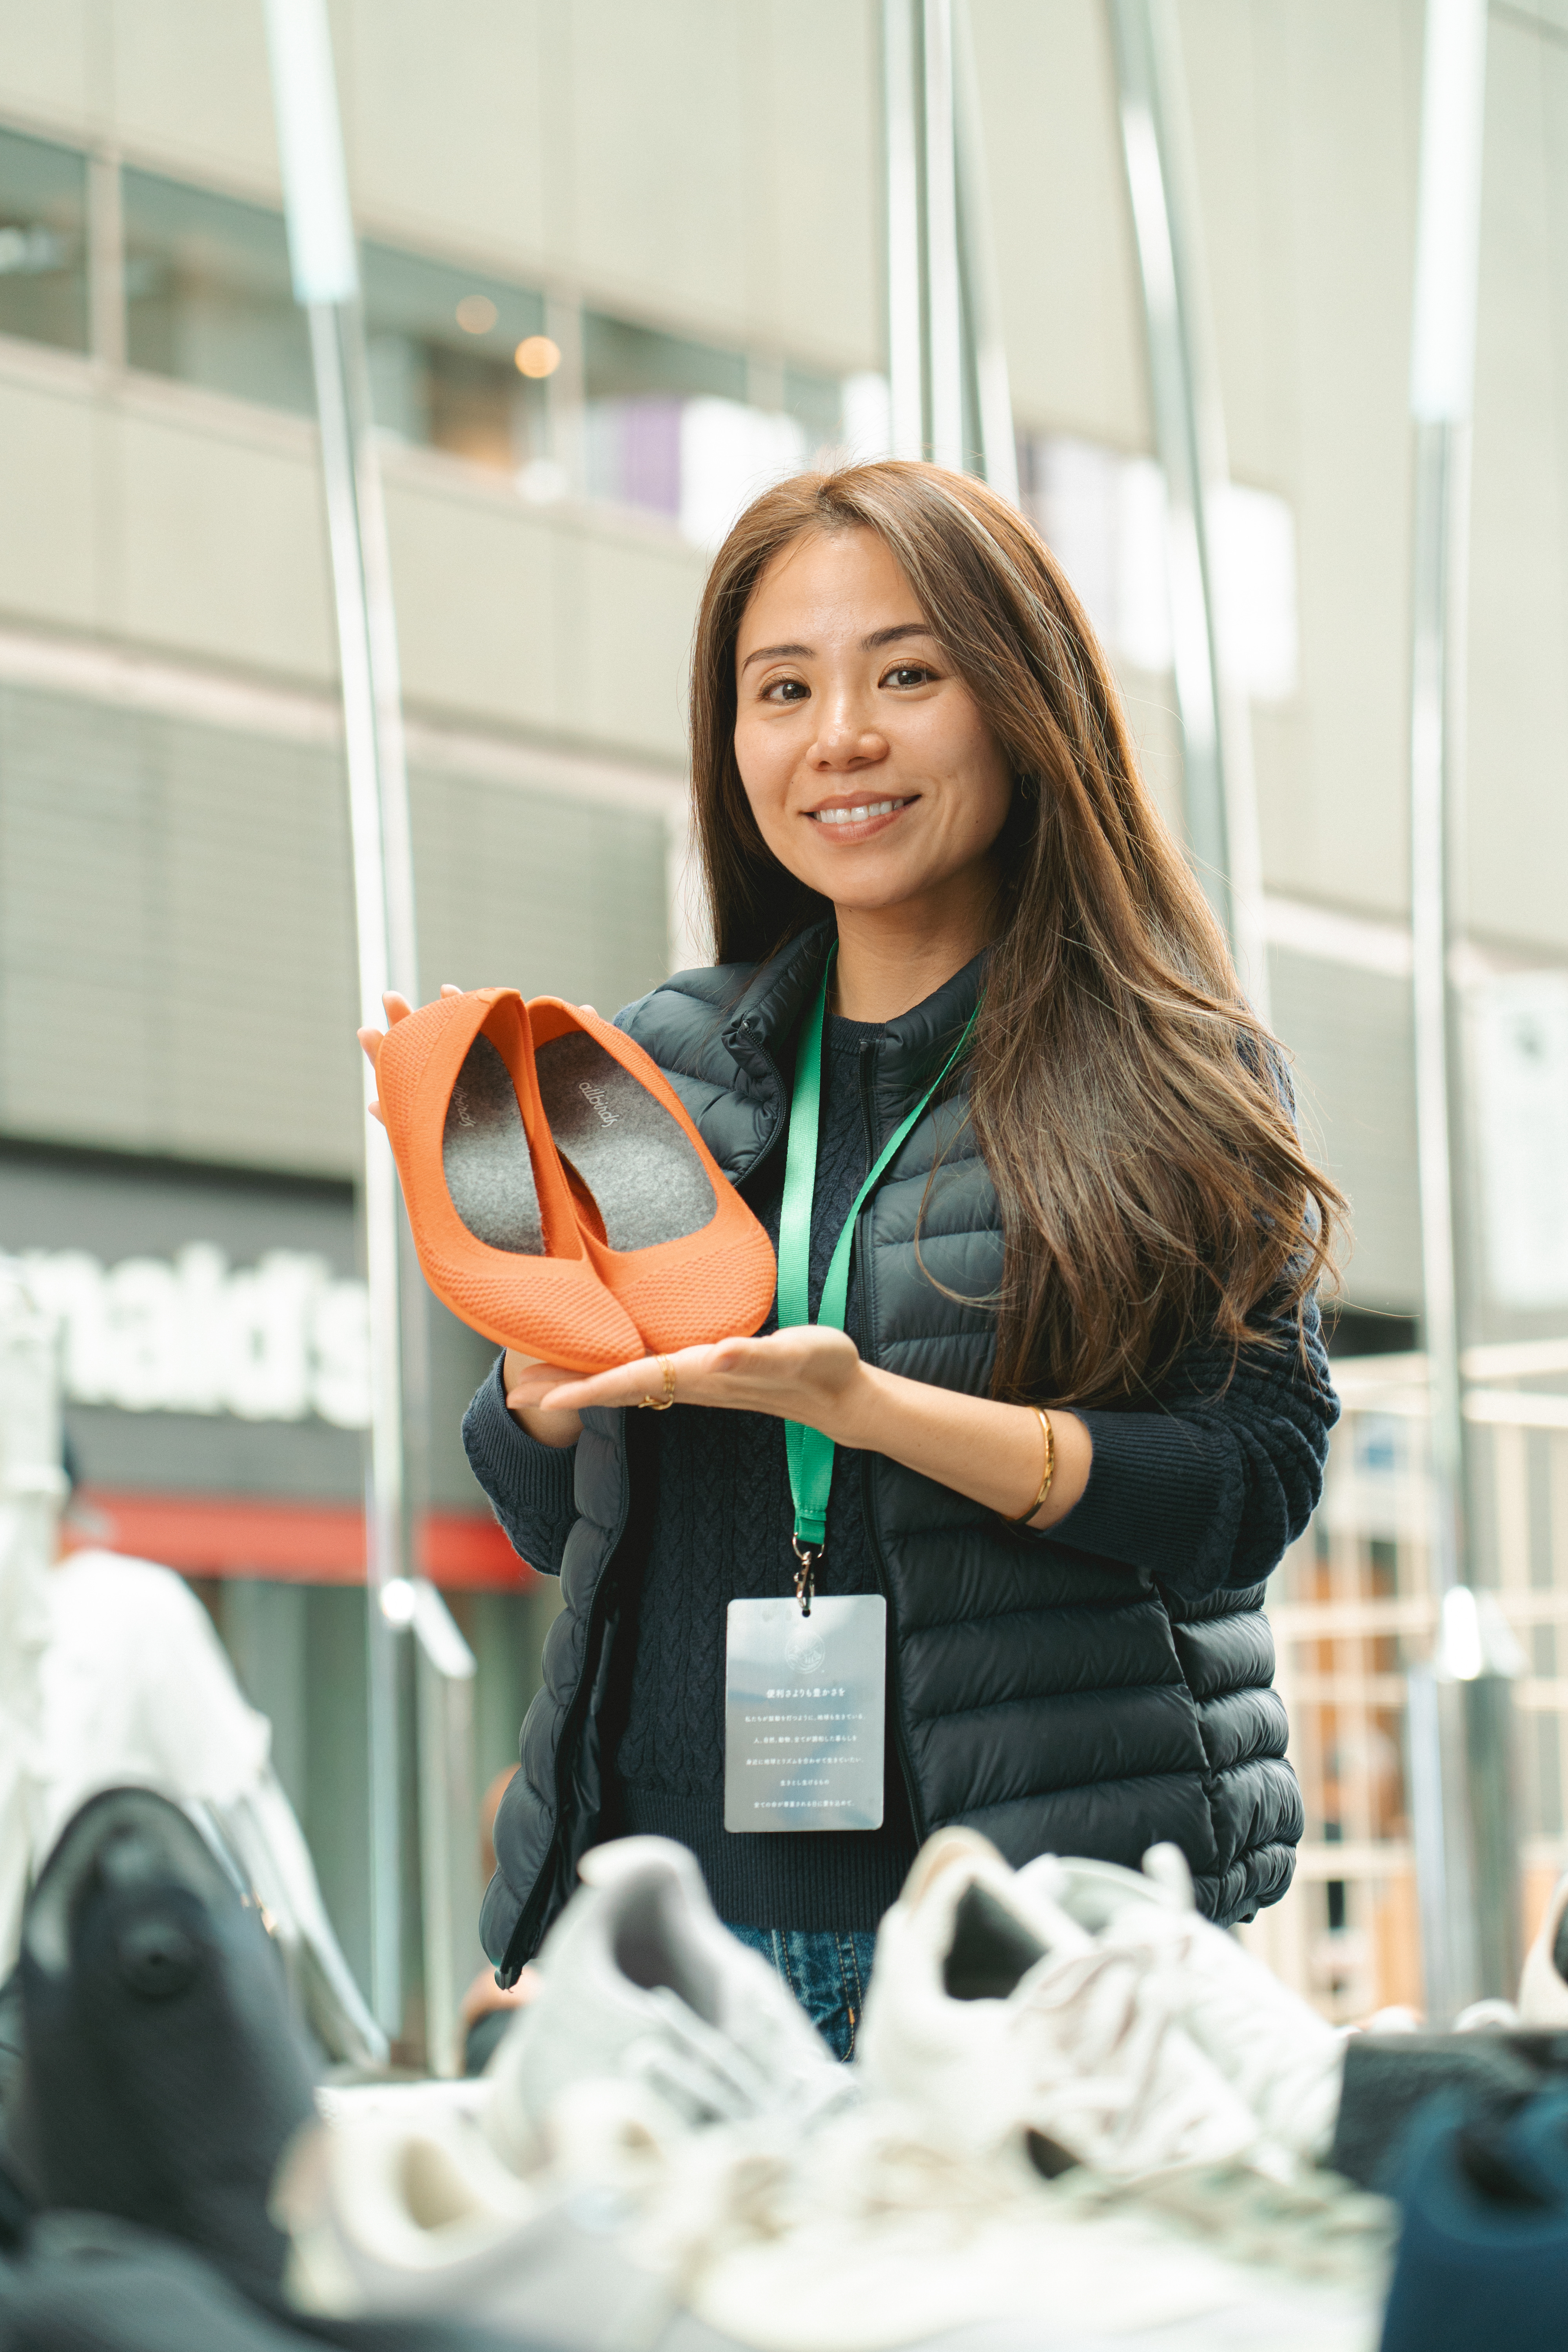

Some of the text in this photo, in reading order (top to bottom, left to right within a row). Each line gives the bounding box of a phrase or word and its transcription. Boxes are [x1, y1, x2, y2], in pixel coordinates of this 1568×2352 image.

[452, 1082, 477, 1127] llbirds
[579, 1082, 620, 1127] allbirds
[766, 1687, 846, 1699] 便利さよりも豊かさを
